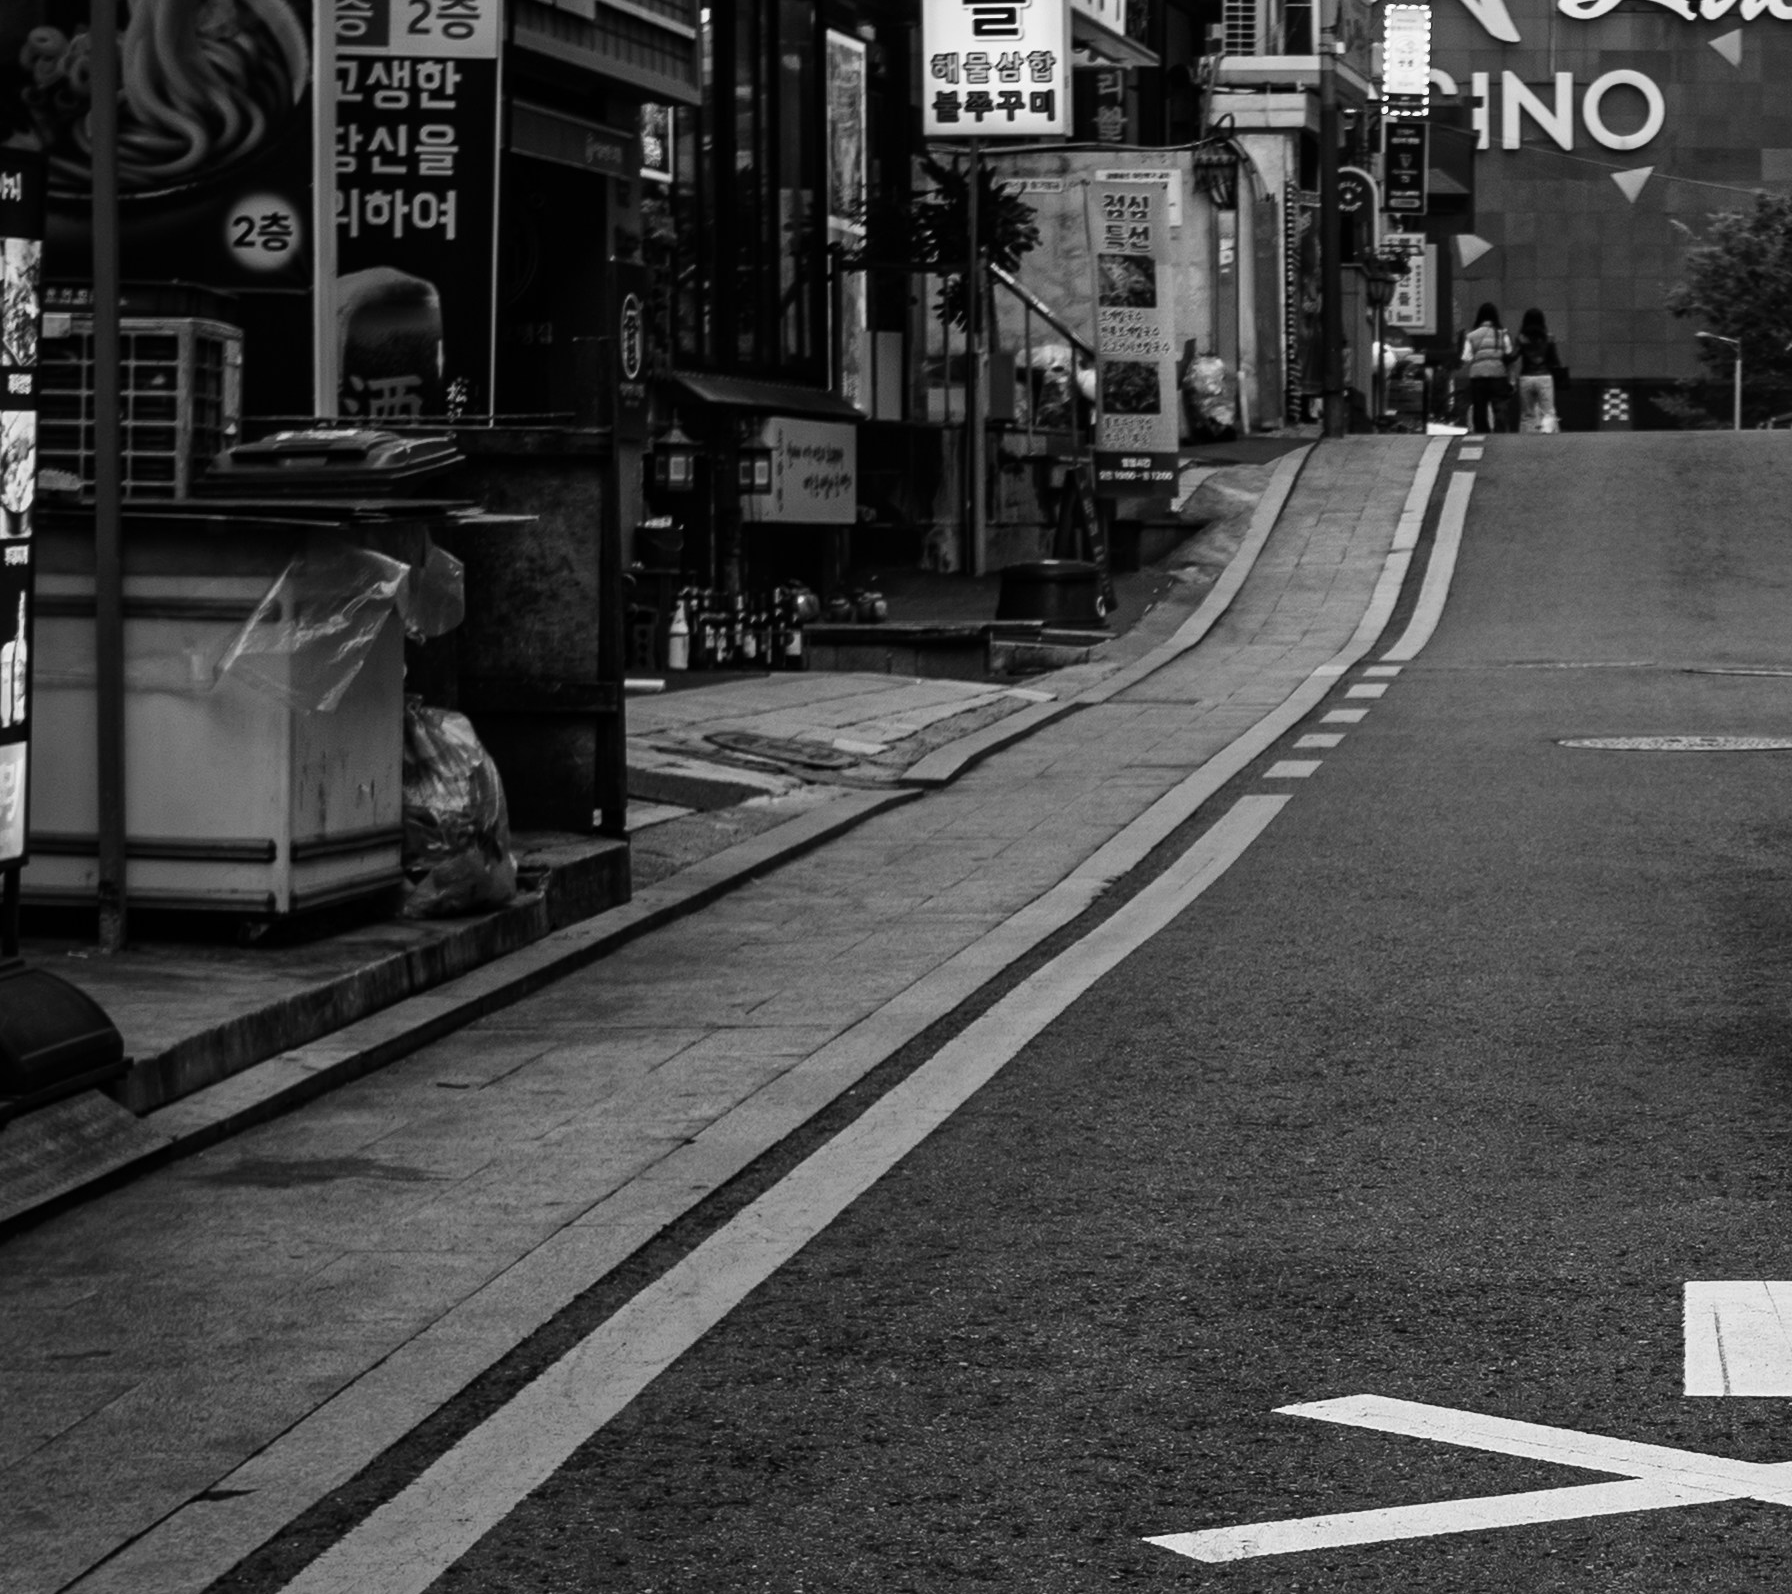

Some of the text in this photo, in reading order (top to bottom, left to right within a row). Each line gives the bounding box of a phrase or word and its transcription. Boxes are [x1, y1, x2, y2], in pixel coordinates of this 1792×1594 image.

[930, 51, 1056, 85] 해물삼합
[932, 89, 1056, 123] 불쭈꾸미
[1428, 68, 1666, 151] INO
[1103, 195, 1151, 220] 점심
[232, 213, 293, 251] 2층
